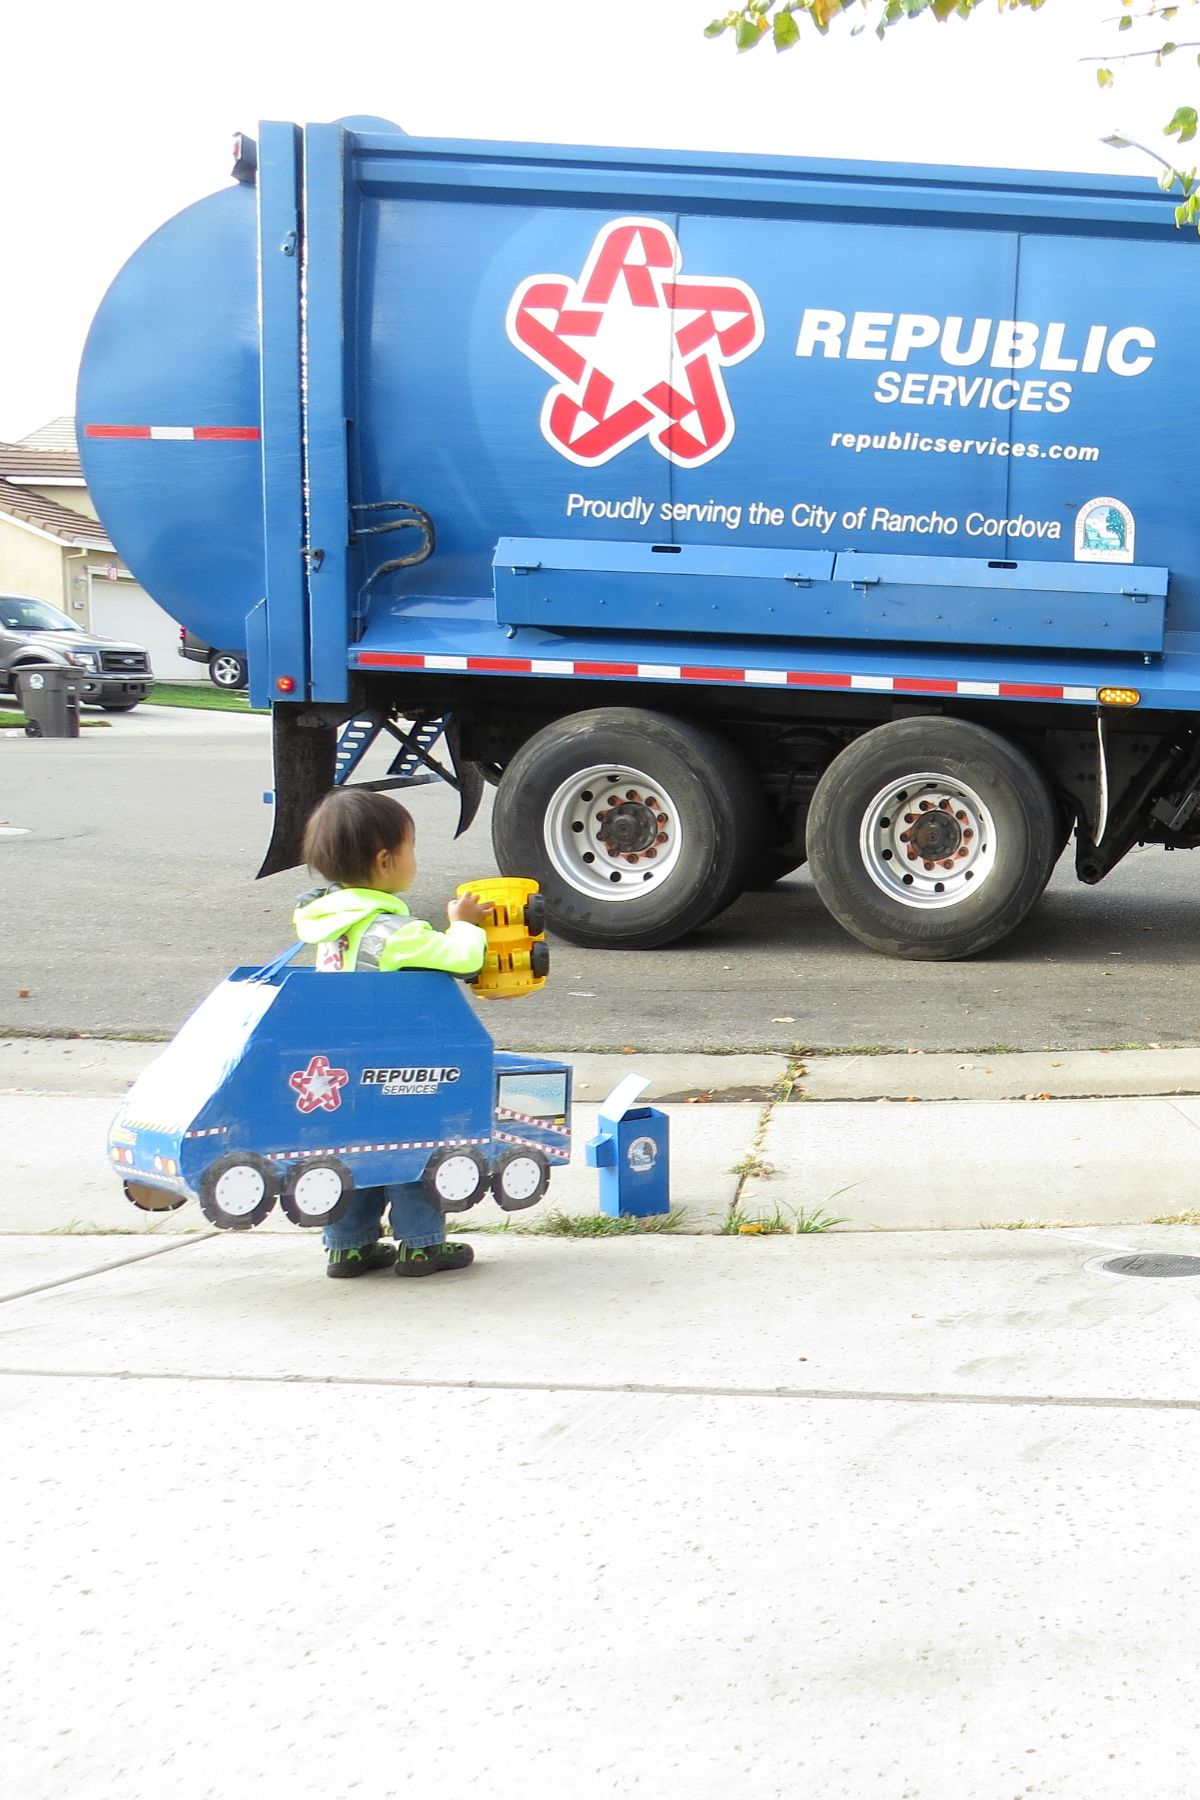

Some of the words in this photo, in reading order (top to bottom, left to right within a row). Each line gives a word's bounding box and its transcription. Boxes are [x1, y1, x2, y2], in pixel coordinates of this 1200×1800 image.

[795, 308, 1156, 377] REPUBLIC
[873, 371, 1073, 414] SERVICES
[830, 431, 1100, 462] republicservices.com
[566, 493, 655, 526] Proudly
[659, 499, 743, 530] serving
[748, 501, 785, 526] the
[791, 503, 837, 534] City
[842, 506, 868, 530] of
[871, 507, 959, 535] Rancho
[965, 512, 1062, 539] Cordova
[362, 1069, 459, 1083] REPUBLIC
[383, 1085, 437, 1094] SERVICES
